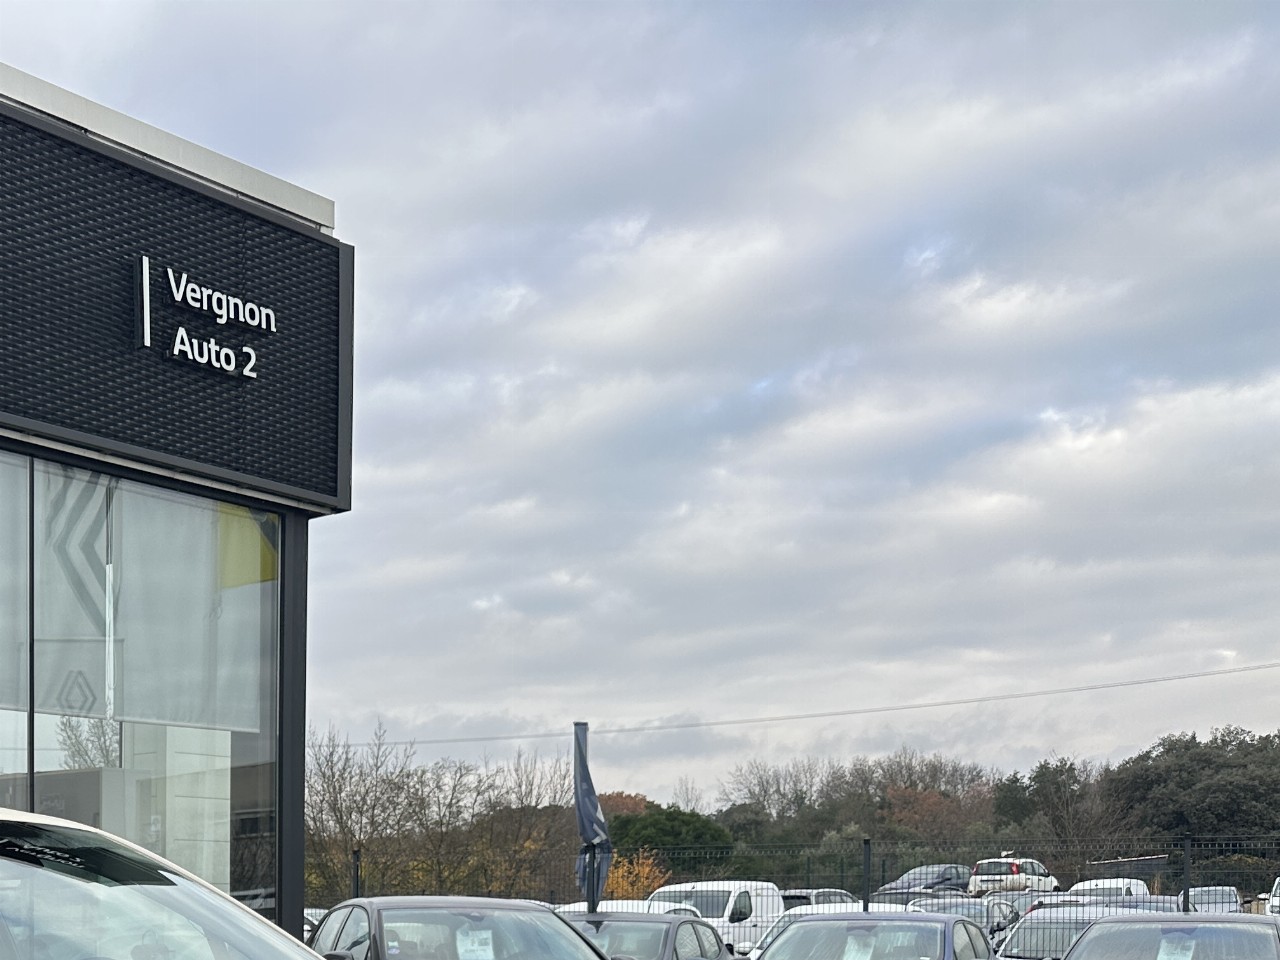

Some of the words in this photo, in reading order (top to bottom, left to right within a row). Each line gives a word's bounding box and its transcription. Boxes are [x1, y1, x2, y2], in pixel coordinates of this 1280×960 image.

[167, 267, 277, 332] Vergnon
[173, 326, 236, 372] Auto
[242, 346, 257, 379] 2
